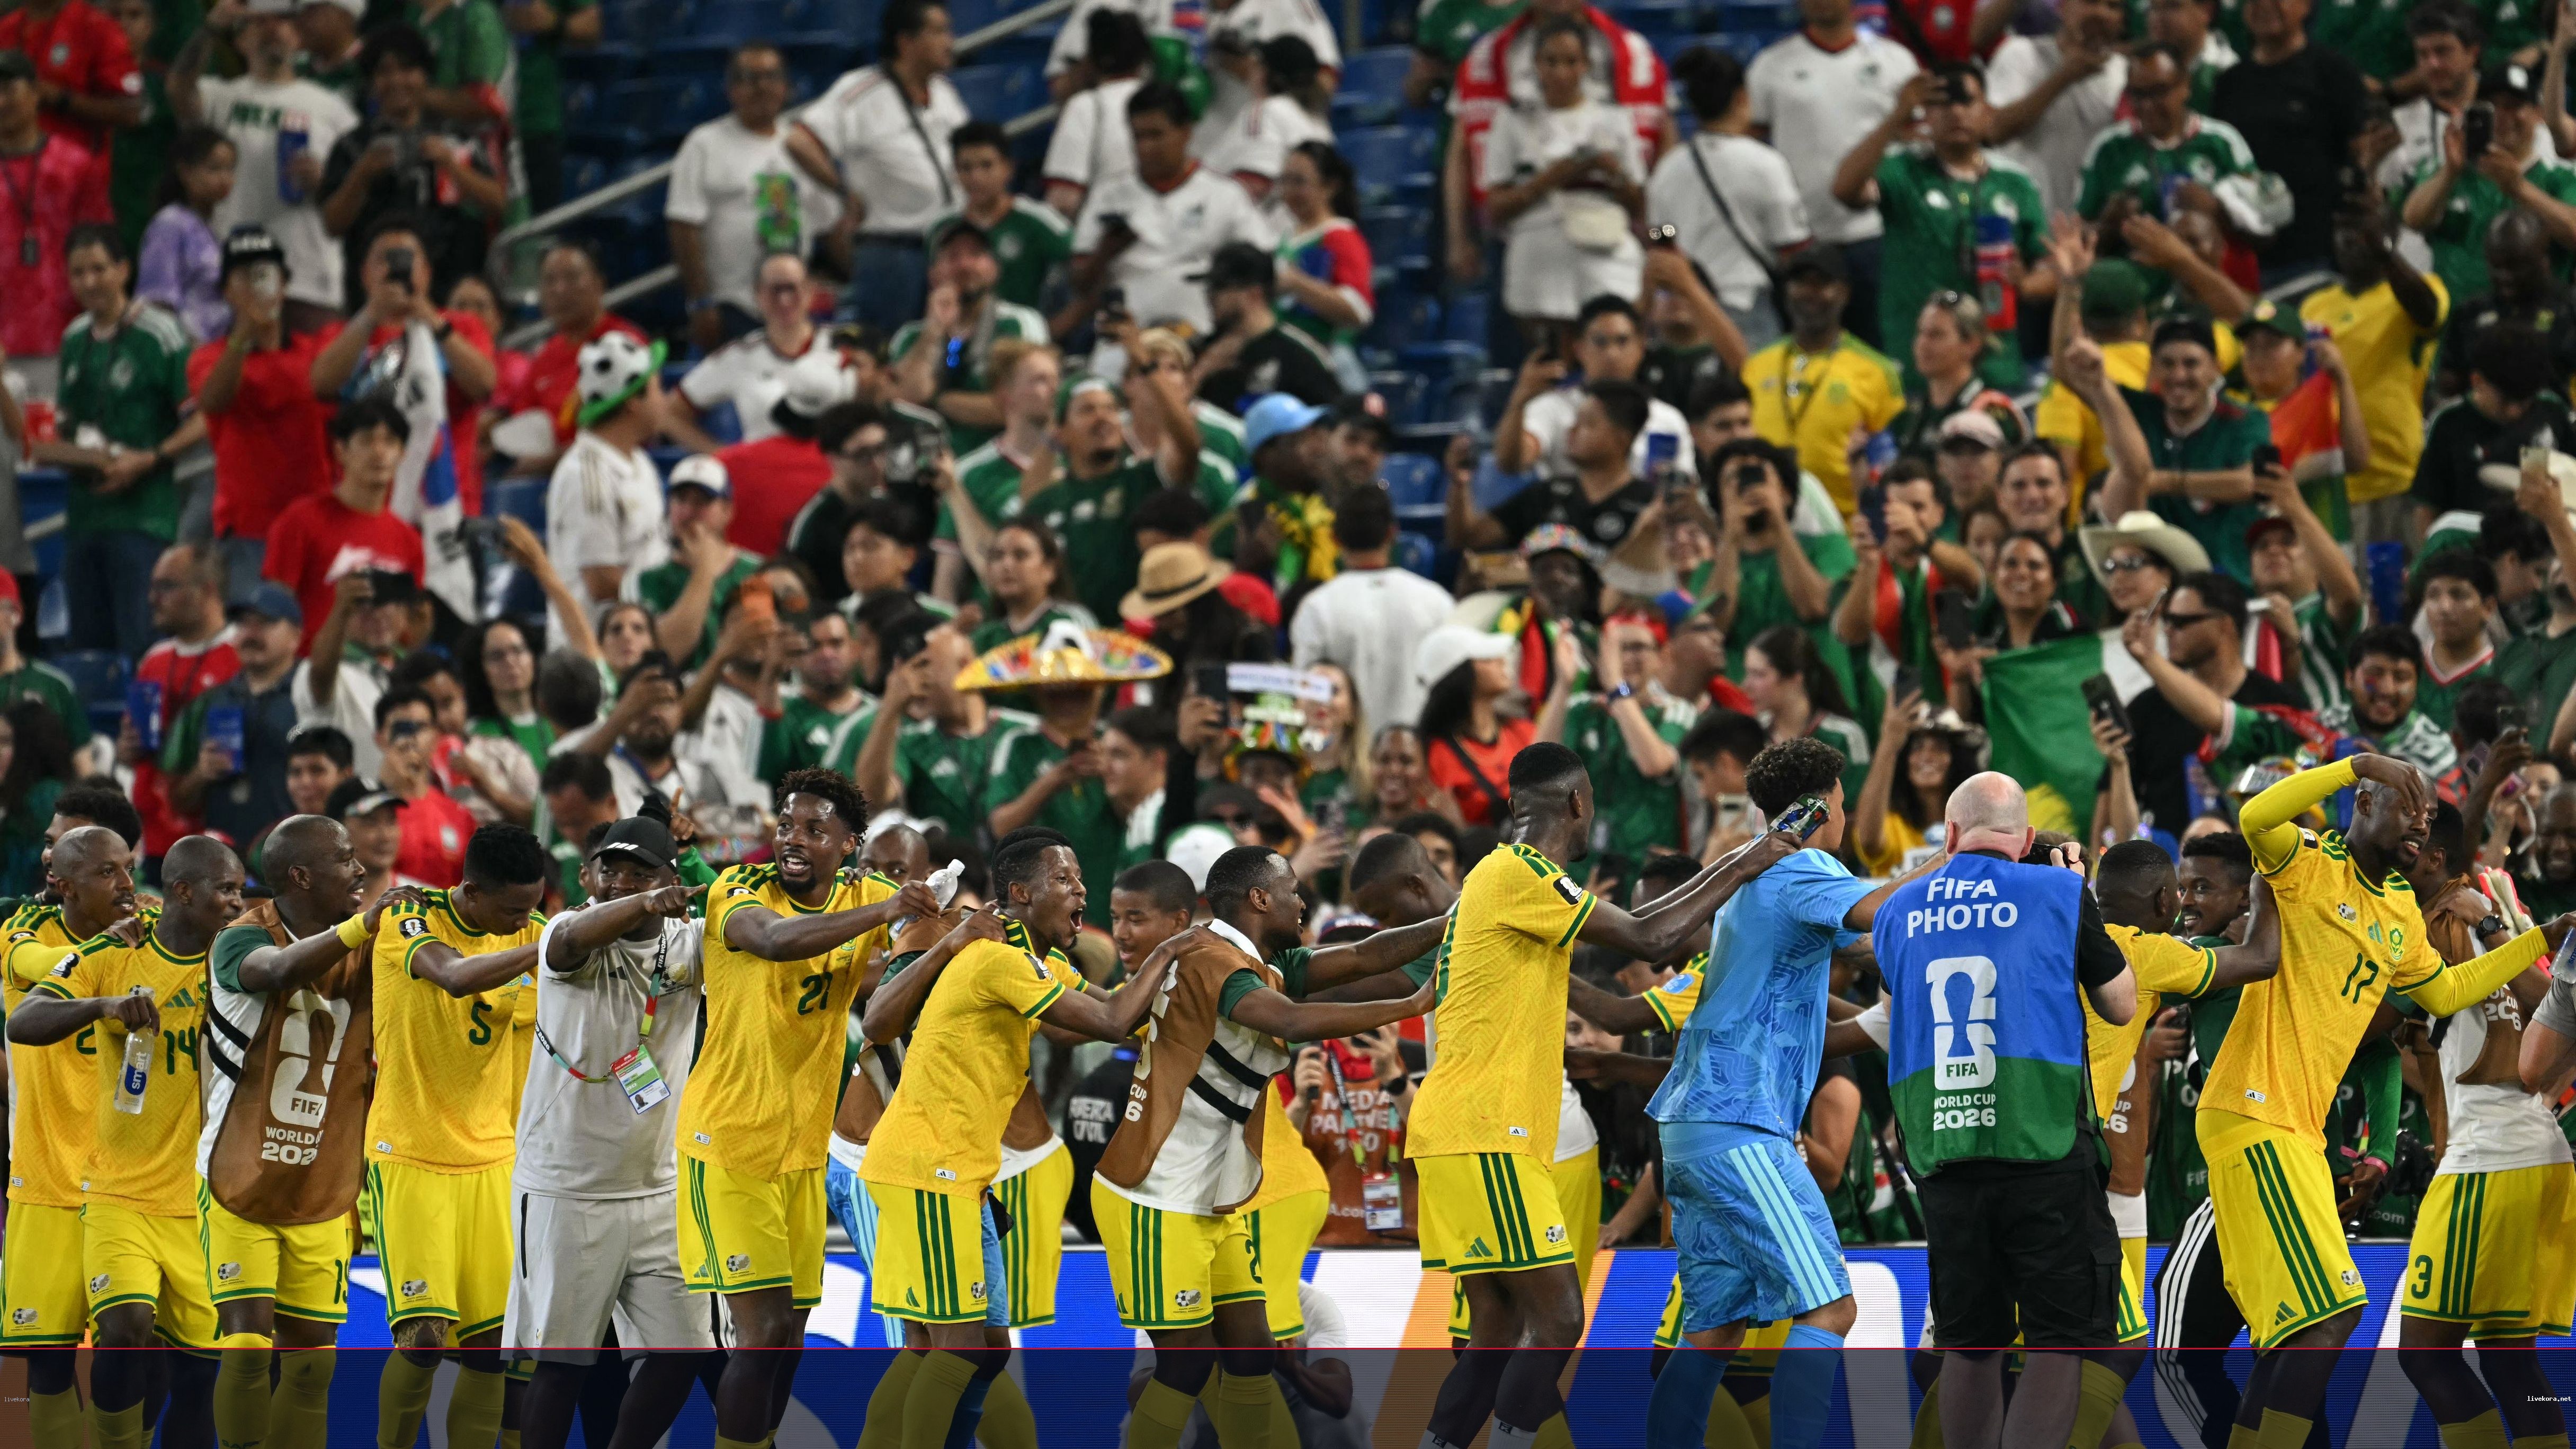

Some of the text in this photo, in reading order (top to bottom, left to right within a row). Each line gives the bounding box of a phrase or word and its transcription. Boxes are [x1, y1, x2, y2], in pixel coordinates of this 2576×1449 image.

[1927, 877, 1997, 902] FIFA
[1908, 902, 2018, 938] PHOTO
[2341, 952, 2379, 1004] 17
[797, 971, 833, 1015] 21
[163, 1026, 198, 1075] 14
[538, 1032, 550, 1050] 2026
[131, 1051, 147, 1090] smart
[1946, 1062, 1979, 1078] FIFA
[1130, 1084, 1147, 1101] CUP
[1321, 1090, 1390, 1111] MEDA
[1934, 1094, 1996, 1110] WORLD CUP
[2114, 1101, 2132, 1112] UP
[1933, 1108, 1996, 1131] 2026
[265, 1126, 315, 1145] WORLD
[261, 1141, 318, 1166] 202
[2411, 1255, 2434, 1300] 3
